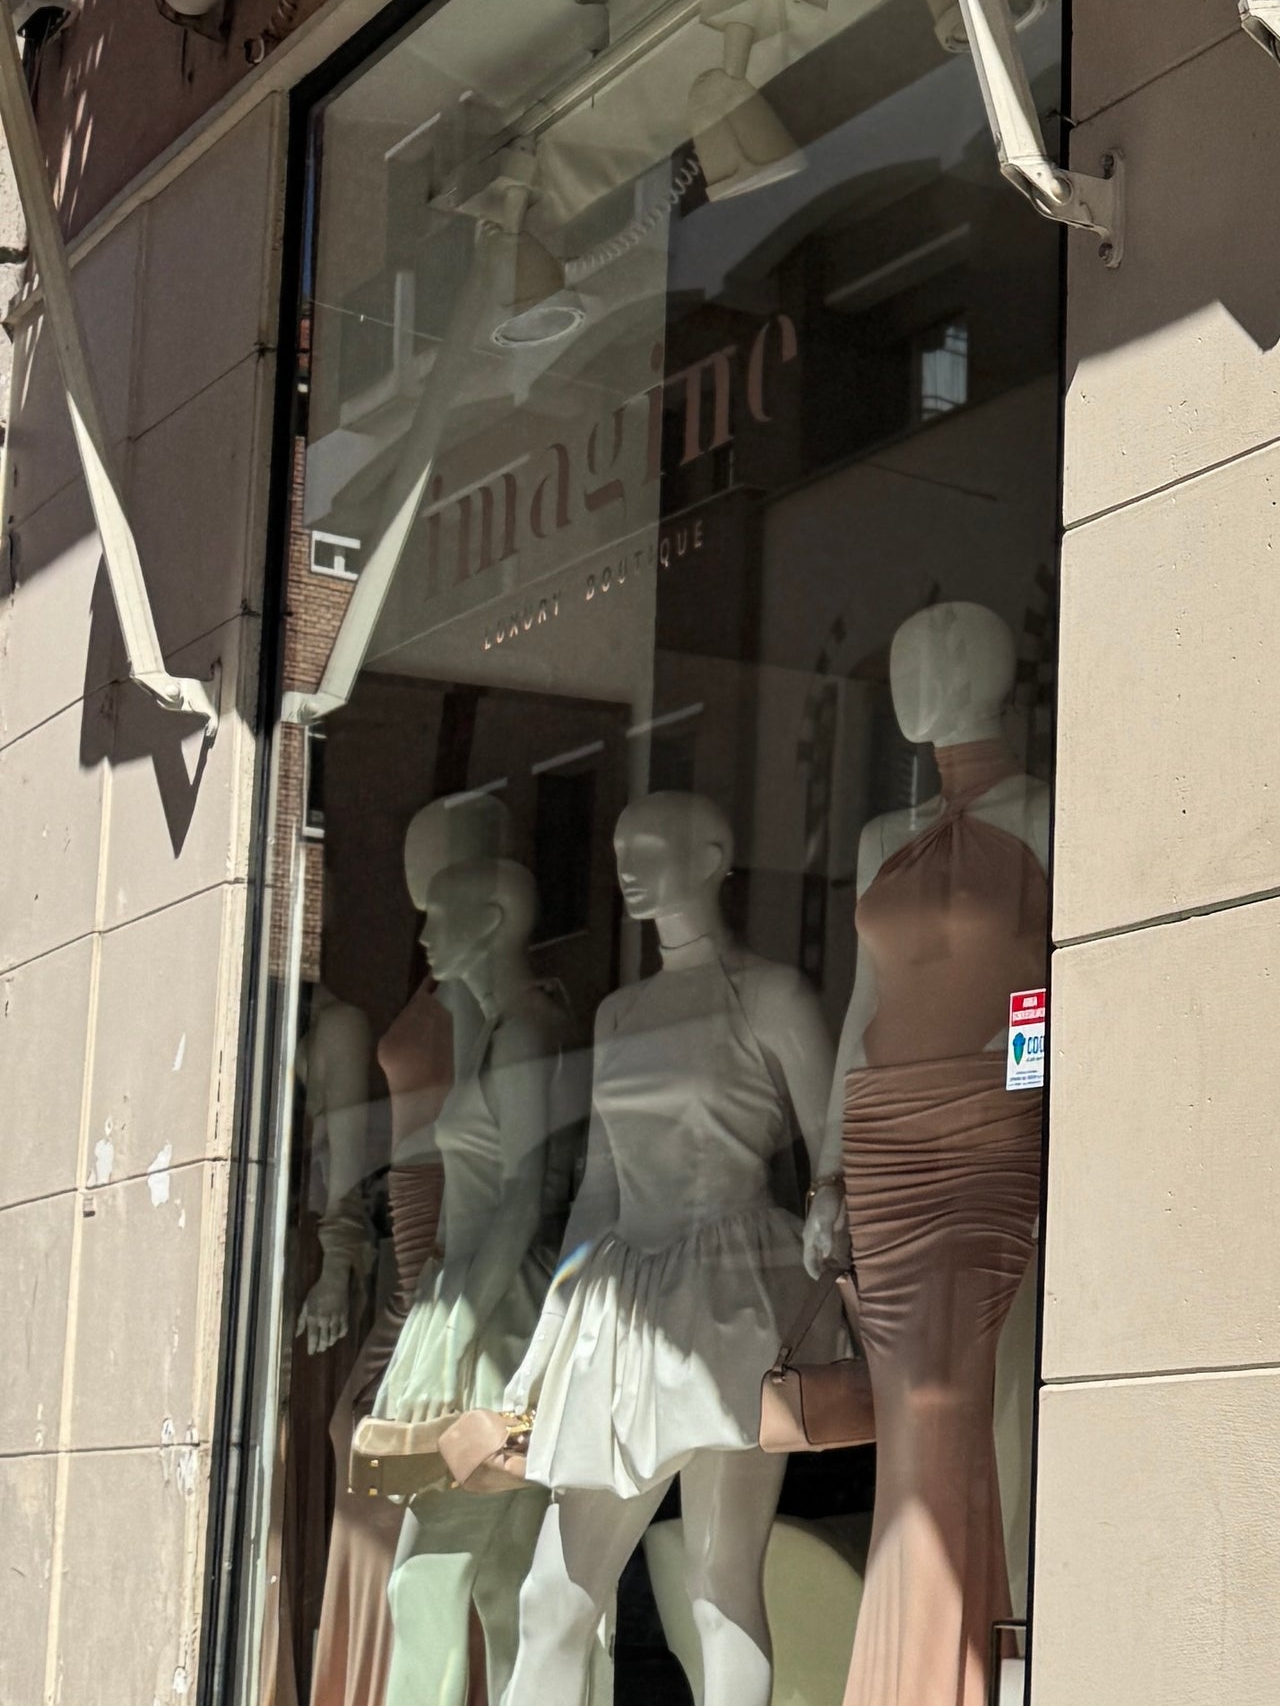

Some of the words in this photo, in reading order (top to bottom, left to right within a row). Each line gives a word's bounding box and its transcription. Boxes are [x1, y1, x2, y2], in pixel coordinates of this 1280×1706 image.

[425, 315, 797, 601] imagine
[481, 589, 562, 651] LUXURY
[583, 519, 705, 602] BOUTIQUE
